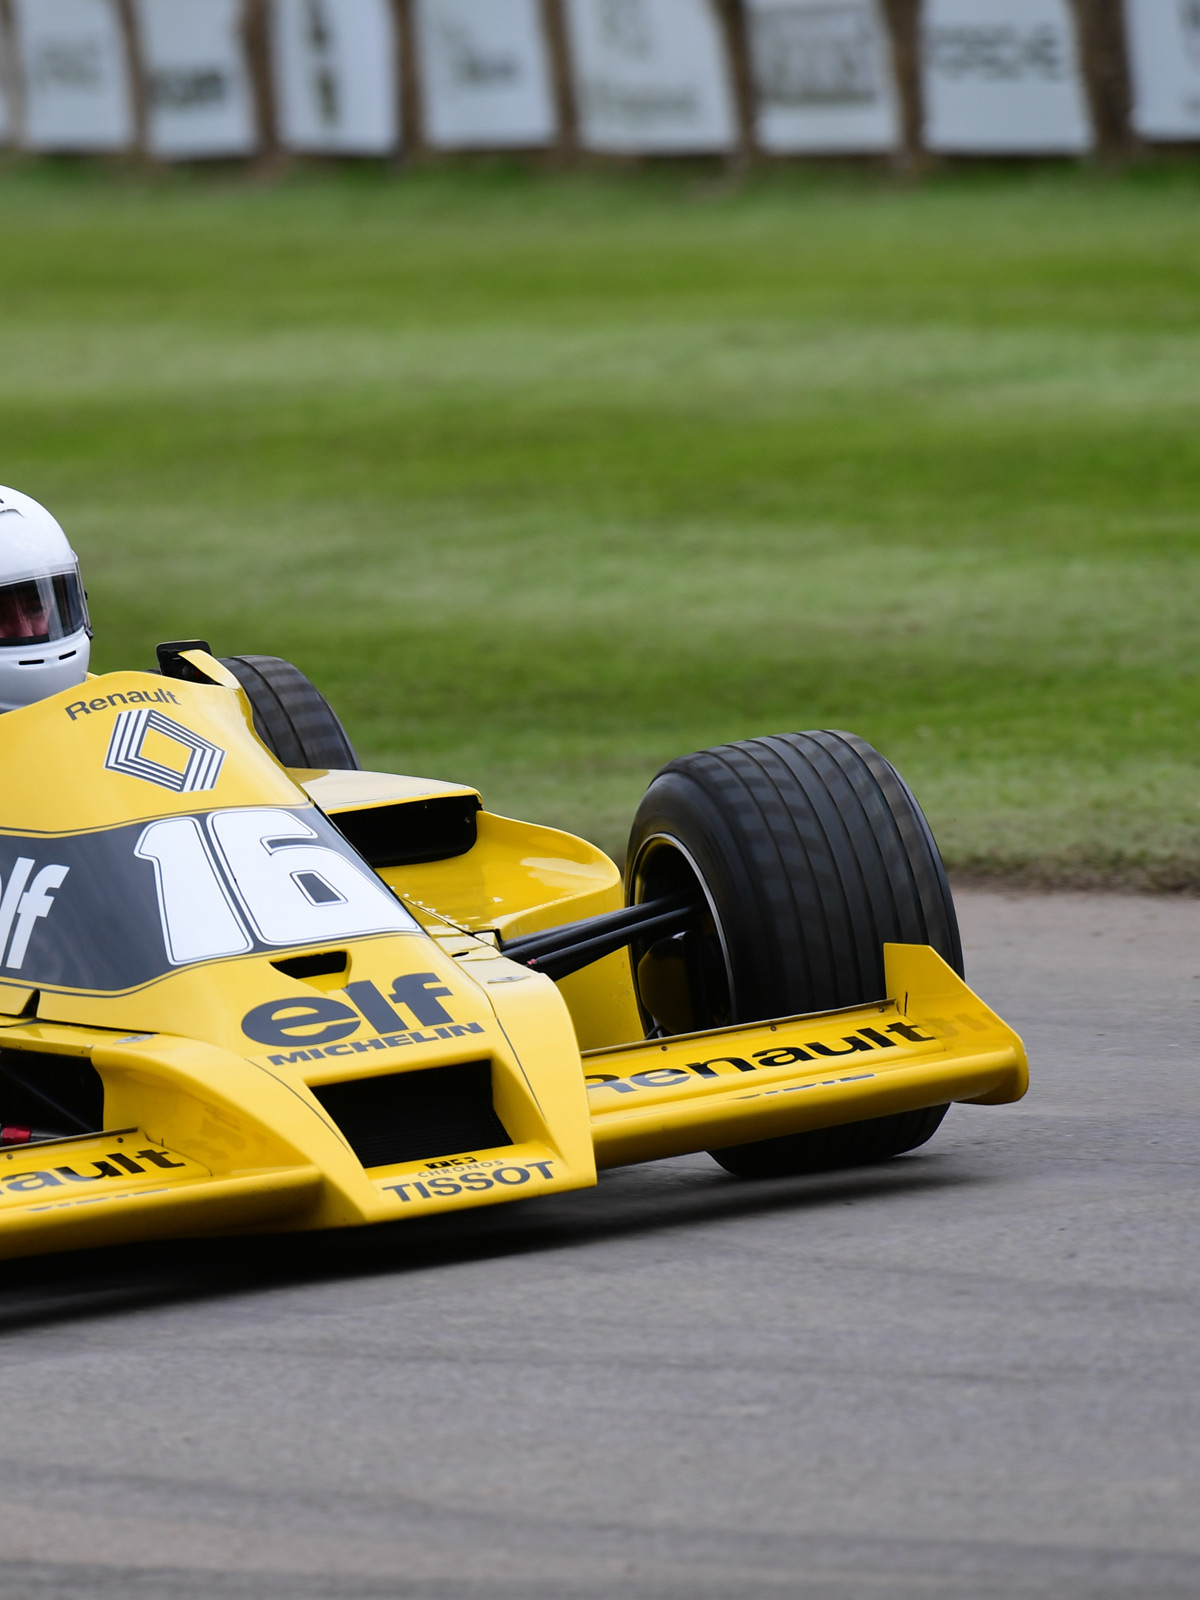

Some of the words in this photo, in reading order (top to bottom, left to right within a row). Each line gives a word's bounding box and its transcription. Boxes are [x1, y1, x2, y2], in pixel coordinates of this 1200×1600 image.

[65, 688, 181, 721] Renault
[134, 808, 423, 965] 16
[241, 972, 454, 1047] elf
[267, 1022, 485, 1066] MICHELIN
[382, 1160, 555, 1202] TISSOT
[417, 1159, 504, 1178] CHRONOS
